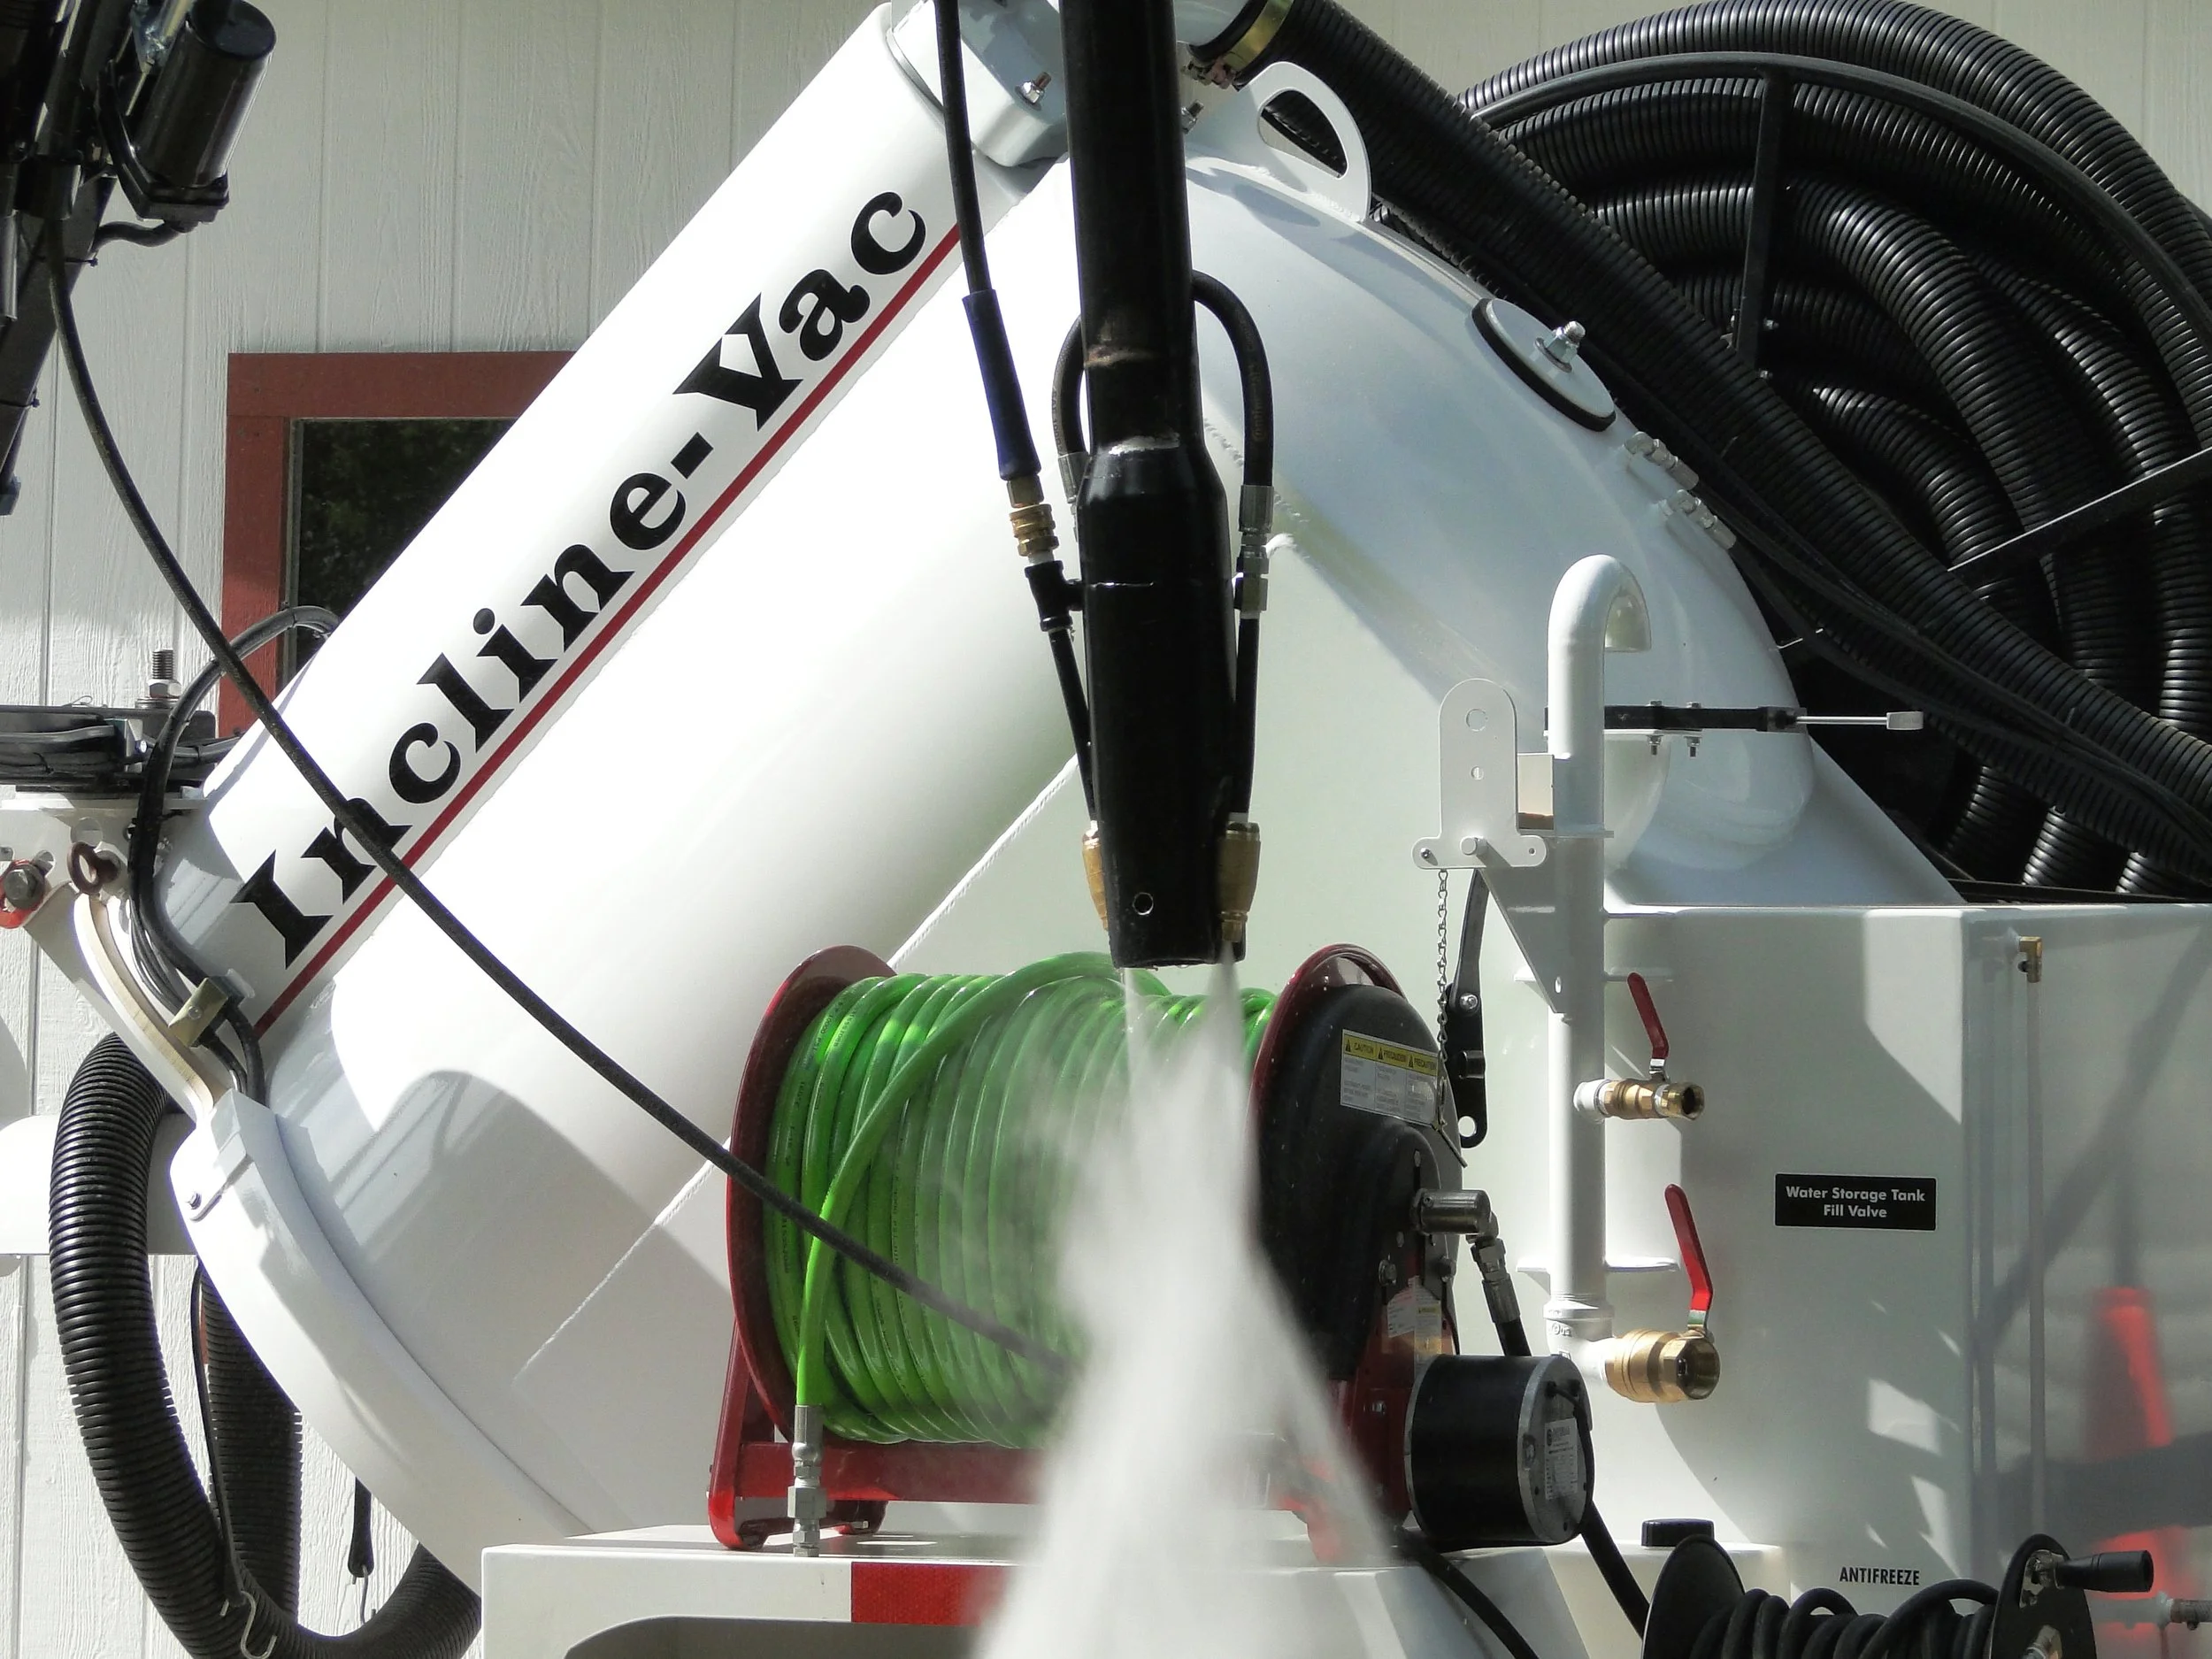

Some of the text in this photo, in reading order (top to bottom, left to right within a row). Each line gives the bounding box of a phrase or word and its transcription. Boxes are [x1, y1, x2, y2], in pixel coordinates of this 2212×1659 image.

[229, 191, 926, 968] Incline-Vac
[1354, 1042, 1374, 1055] CAUTION
[1786, 1186, 1925, 1202] Water Storage Tank
[1824, 1204, 1887, 1218] Fill Valve
[1839, 1566, 1920, 1586] ANTIFREEZE
